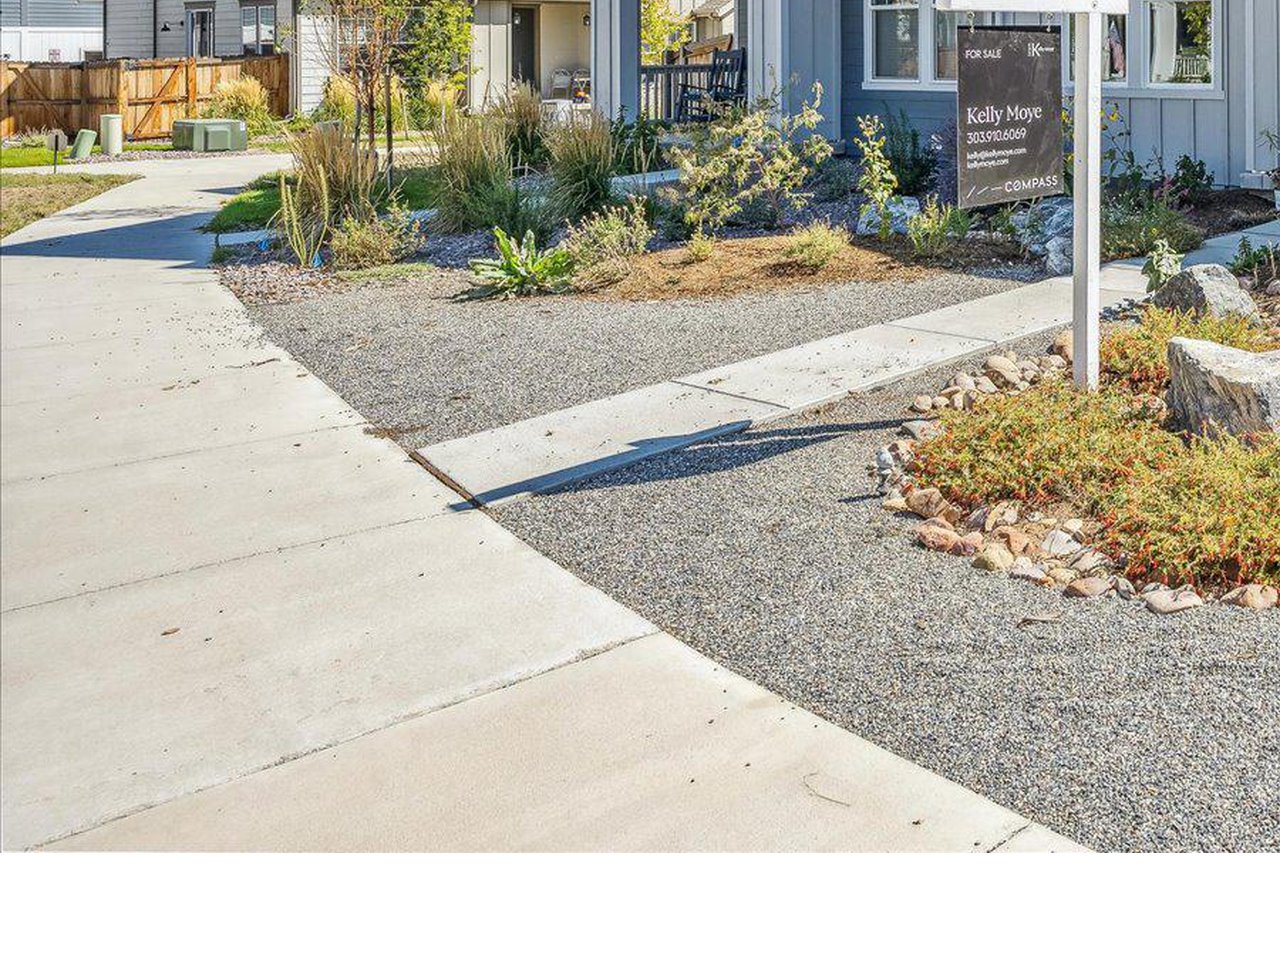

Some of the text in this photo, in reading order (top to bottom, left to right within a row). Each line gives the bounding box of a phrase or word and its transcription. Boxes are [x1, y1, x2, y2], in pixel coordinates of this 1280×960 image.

[965, 48, 1002, 59] FOR SALE
[967, 105, 1042, 126] Kelly Moye
[966, 127, 1027, 144] 303.910.6069
[1004, 175, 1058, 192] COMPASS
